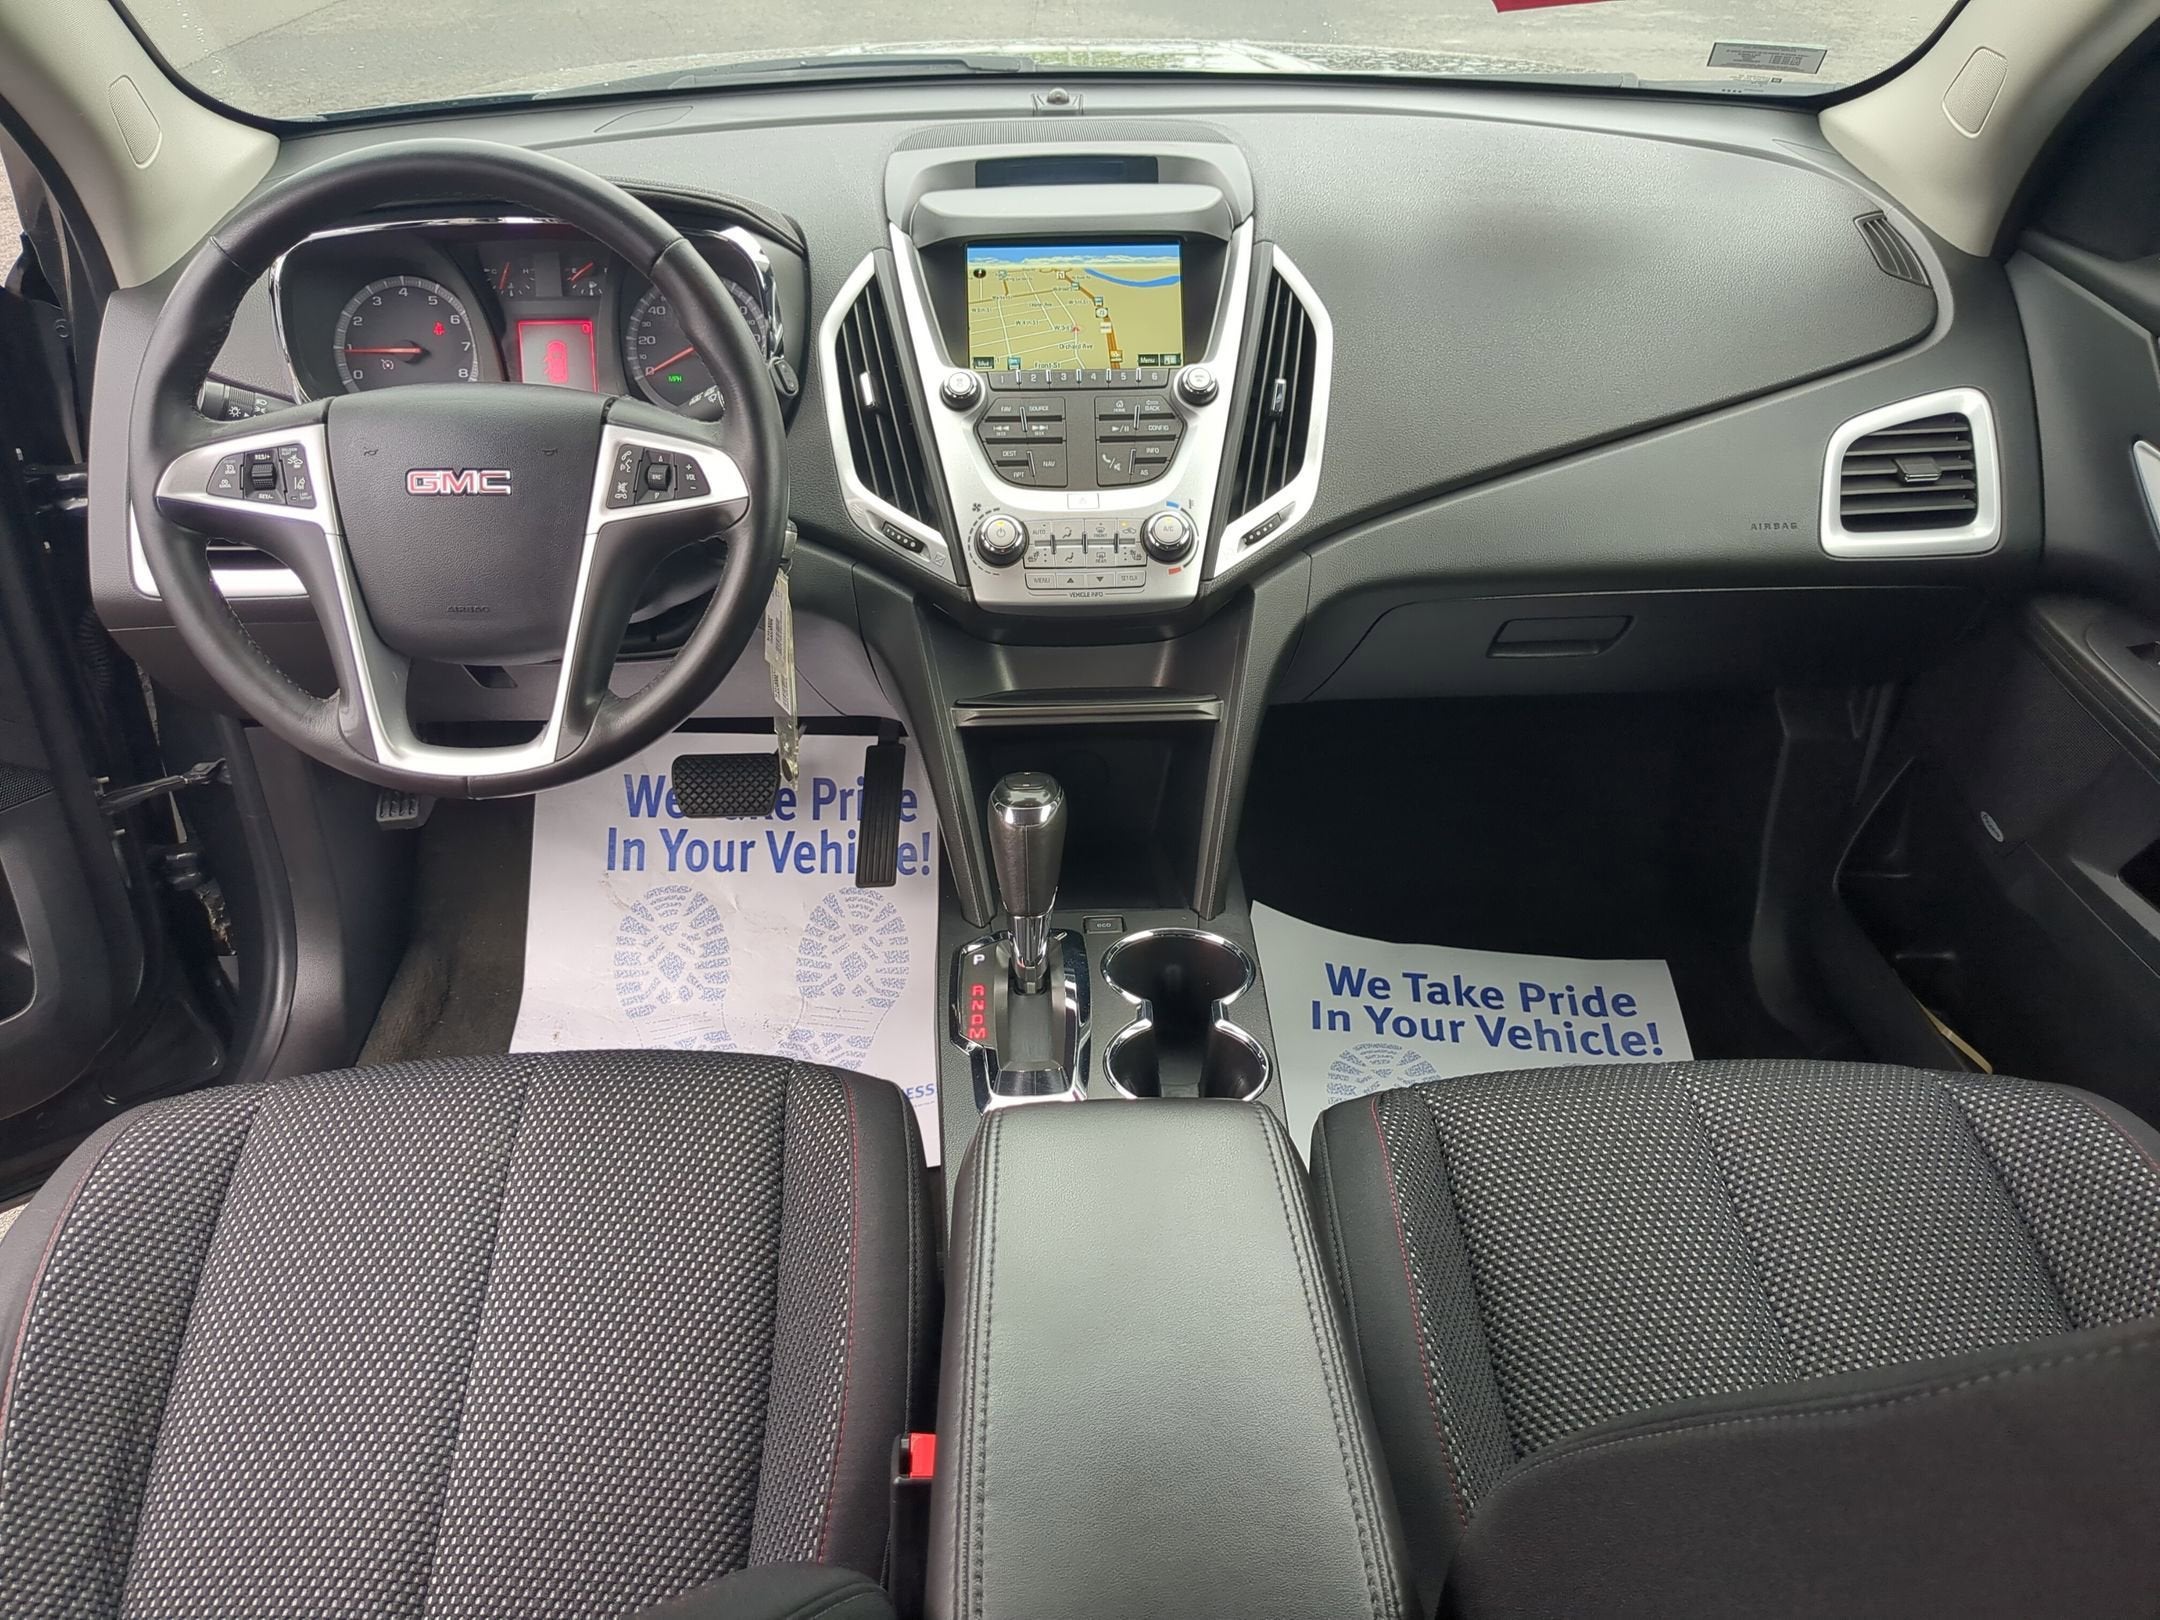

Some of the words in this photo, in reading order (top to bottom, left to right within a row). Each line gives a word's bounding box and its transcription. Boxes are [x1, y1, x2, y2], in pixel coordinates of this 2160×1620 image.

[399, 288, 408, 296] 4
[373, 296, 382, 305] 3
[428, 296, 438, 305] 5
[648, 306, 665, 315] 40
[353, 316, 362, 326] 2
[450, 315, 460, 324] 6
[638, 336, 656, 345] 20
[461, 342, 471, 351] 7
[353, 370, 363, 379] 0
[459, 369, 468, 377] 8
[1121, 372, 1127, 380] 5
[1031, 374, 1037, 382] 2
[405, 469, 512, 495] GMC
[1751, 522, 1798, 530] AIRBAG
[812, 777, 917, 821] Prie
[607, 827, 646, 872] In
[661, 829, 757, 873] Your
[765, 830, 931, 876] Vehie!
[973, 954, 985, 965] P
[972, 985, 985, 996] R
[1324, 962, 1391, 1000] We
[1402, 972, 1505, 1010] Take
[1518, 982, 1638, 1018] Pride
[972, 1000, 985, 1010] N
[972, 1014, 984, 1025] D
[969, 1027, 986, 1039] M
[1311, 1000, 1351, 1032] In
[1363, 1005, 1466, 1043] Your
[1474, 1014, 1664, 1057] Vehicle!
